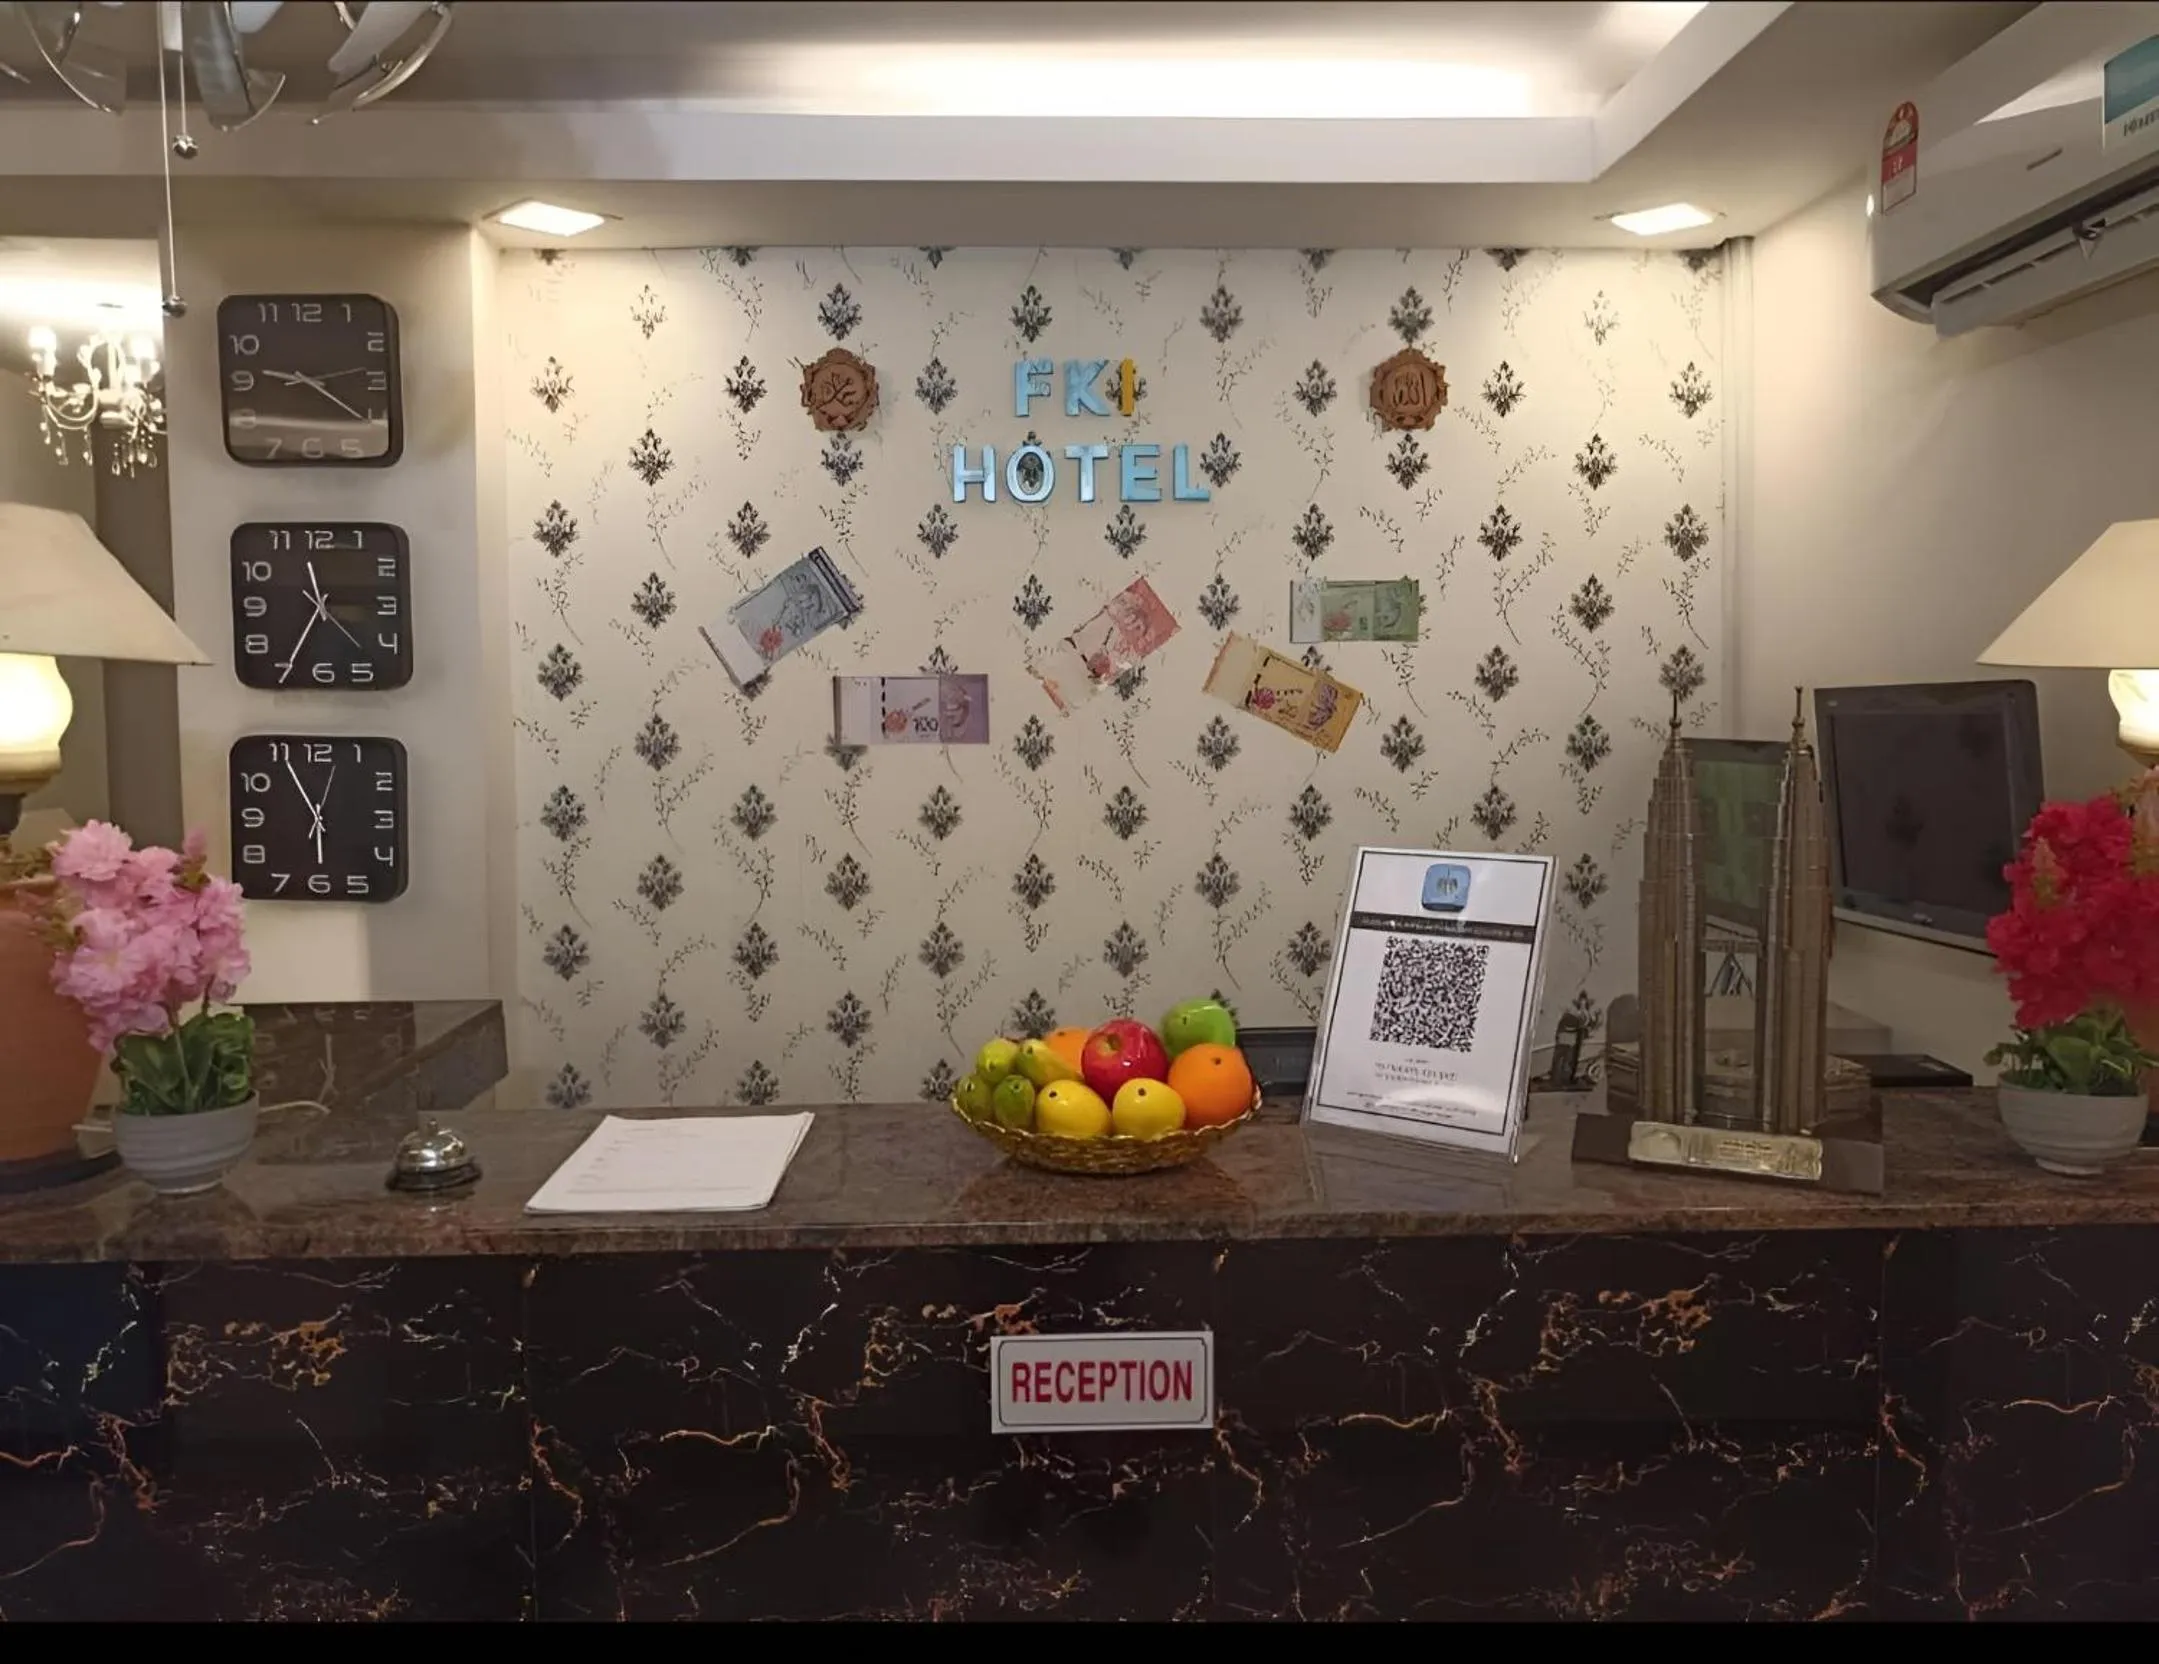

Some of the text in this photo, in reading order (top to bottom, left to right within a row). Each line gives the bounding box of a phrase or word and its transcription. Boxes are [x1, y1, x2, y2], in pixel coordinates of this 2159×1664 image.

[257, 303, 352, 323] 11 12 1
[229, 334, 260, 355] 10
[366, 332, 385, 352] 2
[231, 370, 255, 392] 9
[365, 371, 388, 391] 3
[1013, 358, 1135, 417] FKI
[264, 437, 365, 460] 7 6 5
[952, 443, 1211, 503] HOTEL
[269, 530, 362, 550] 11 12 1
[241, 561, 272, 582] 10
[376, 557, 396, 577] 2
[243, 596, 268, 618] 9
[376, 595, 397, 616] 3
[245, 634, 269, 654] 8
[378, 633, 398, 655] 4
[274, 662, 374, 684] 7 6 5
[269, 742, 361, 763] 11 12 1
[240, 772, 271, 793] 10
[375, 771, 393, 792] 2
[241, 807, 265, 828] 9
[373, 809, 394, 829] 3
[242, 844, 266, 864] 8
[374, 846, 394, 867] 4
[271, 872, 369, 894] 7 6 5
[1011, 1359, 1193, 1403] RECEPTION
